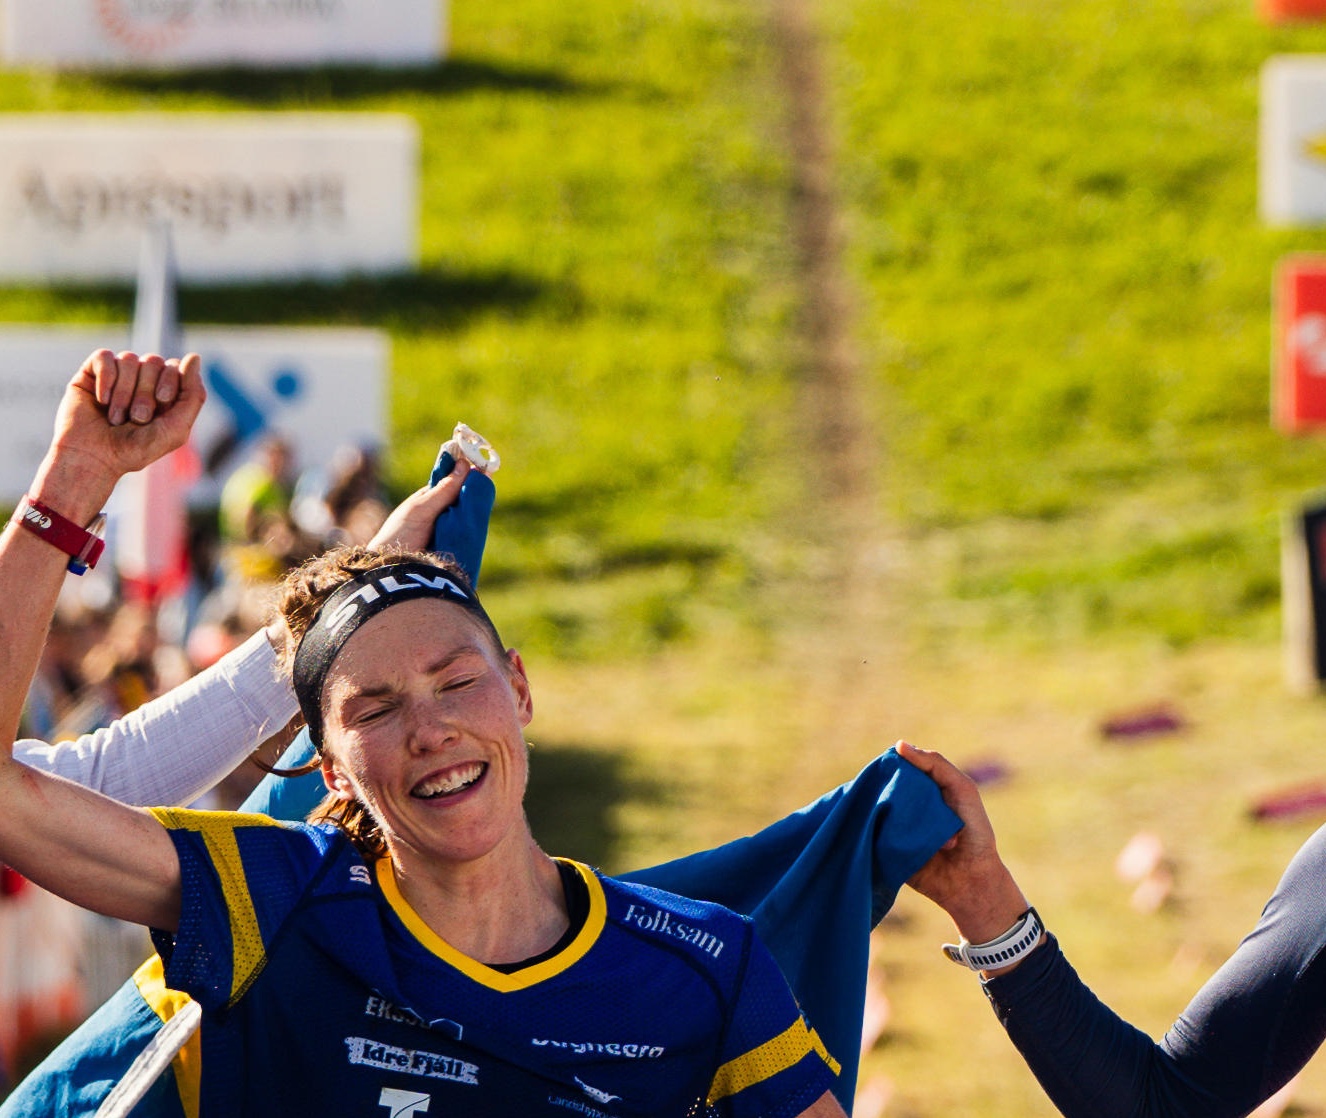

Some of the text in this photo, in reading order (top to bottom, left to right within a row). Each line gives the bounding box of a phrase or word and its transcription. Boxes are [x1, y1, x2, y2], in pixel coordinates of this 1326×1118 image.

[624, 904, 724, 958] Folksam
[362, 1042, 464, 1078] Idre Fjäll
